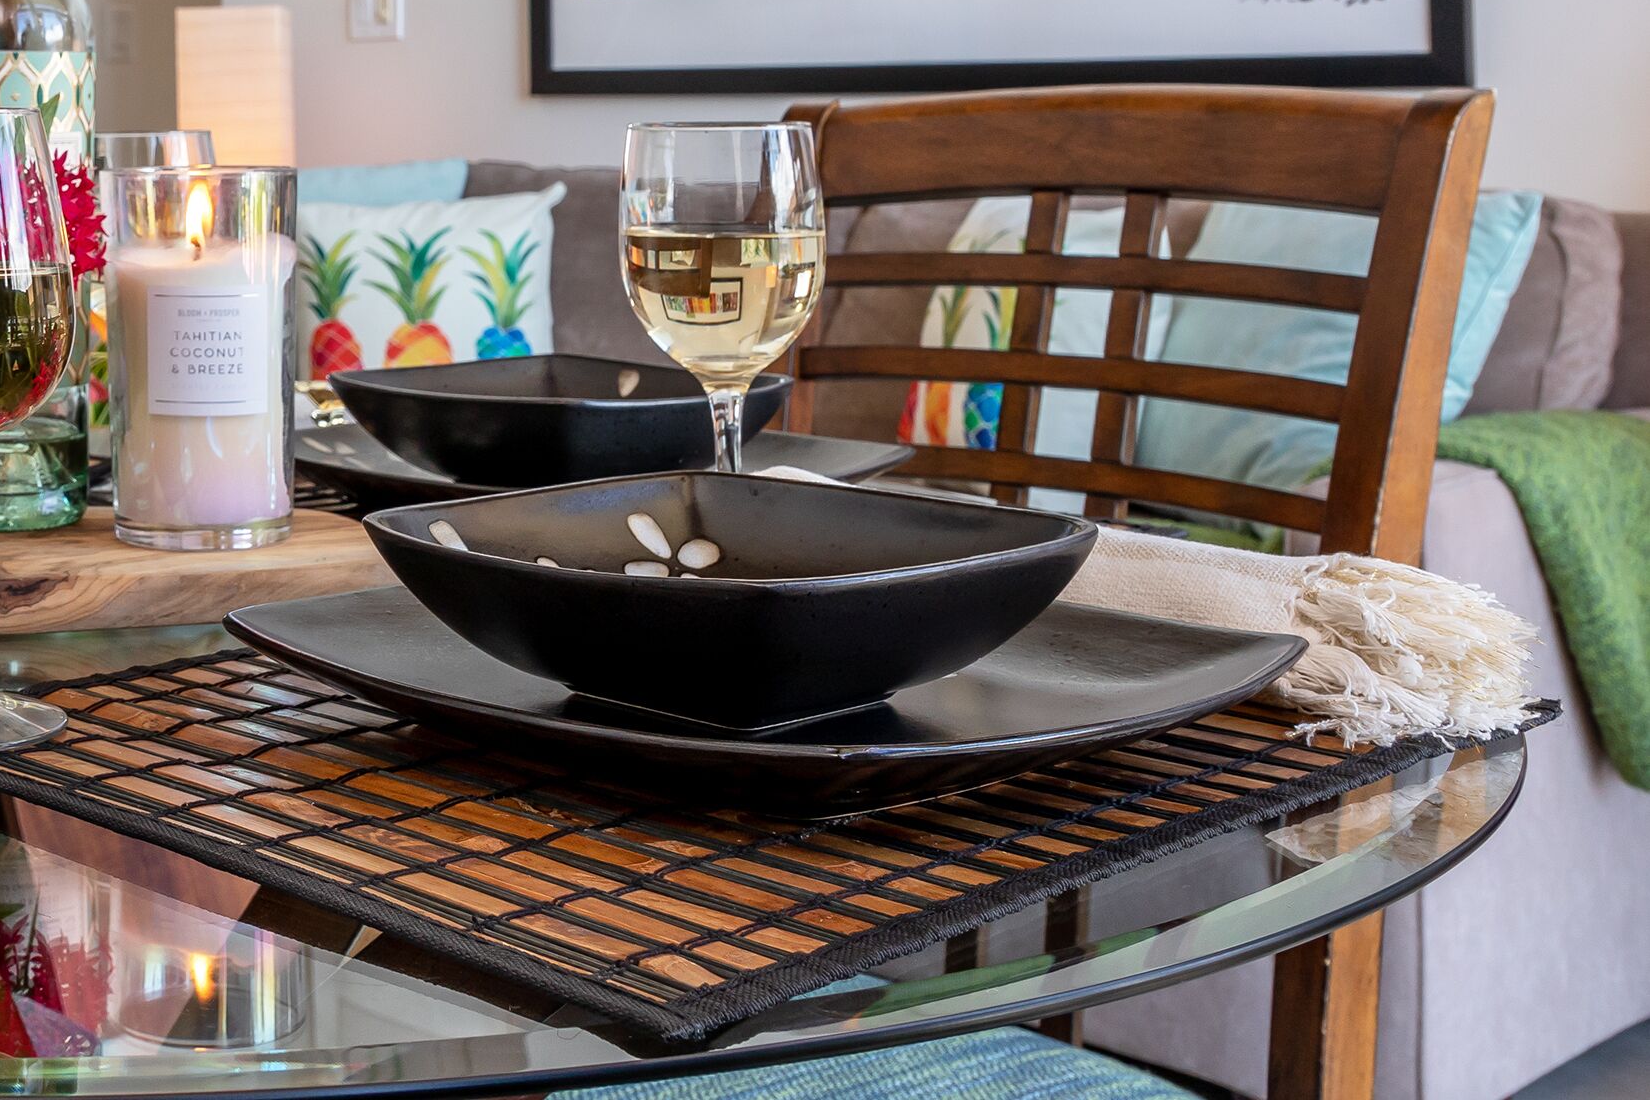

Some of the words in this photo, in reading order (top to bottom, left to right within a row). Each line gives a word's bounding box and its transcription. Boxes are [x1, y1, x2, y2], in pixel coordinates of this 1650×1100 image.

[173, 330, 243, 341] TAHITIAN
[169, 346, 244, 359] COCONUT
[171, 363, 180, 375] &
[187, 363, 244, 375] BREEZE
